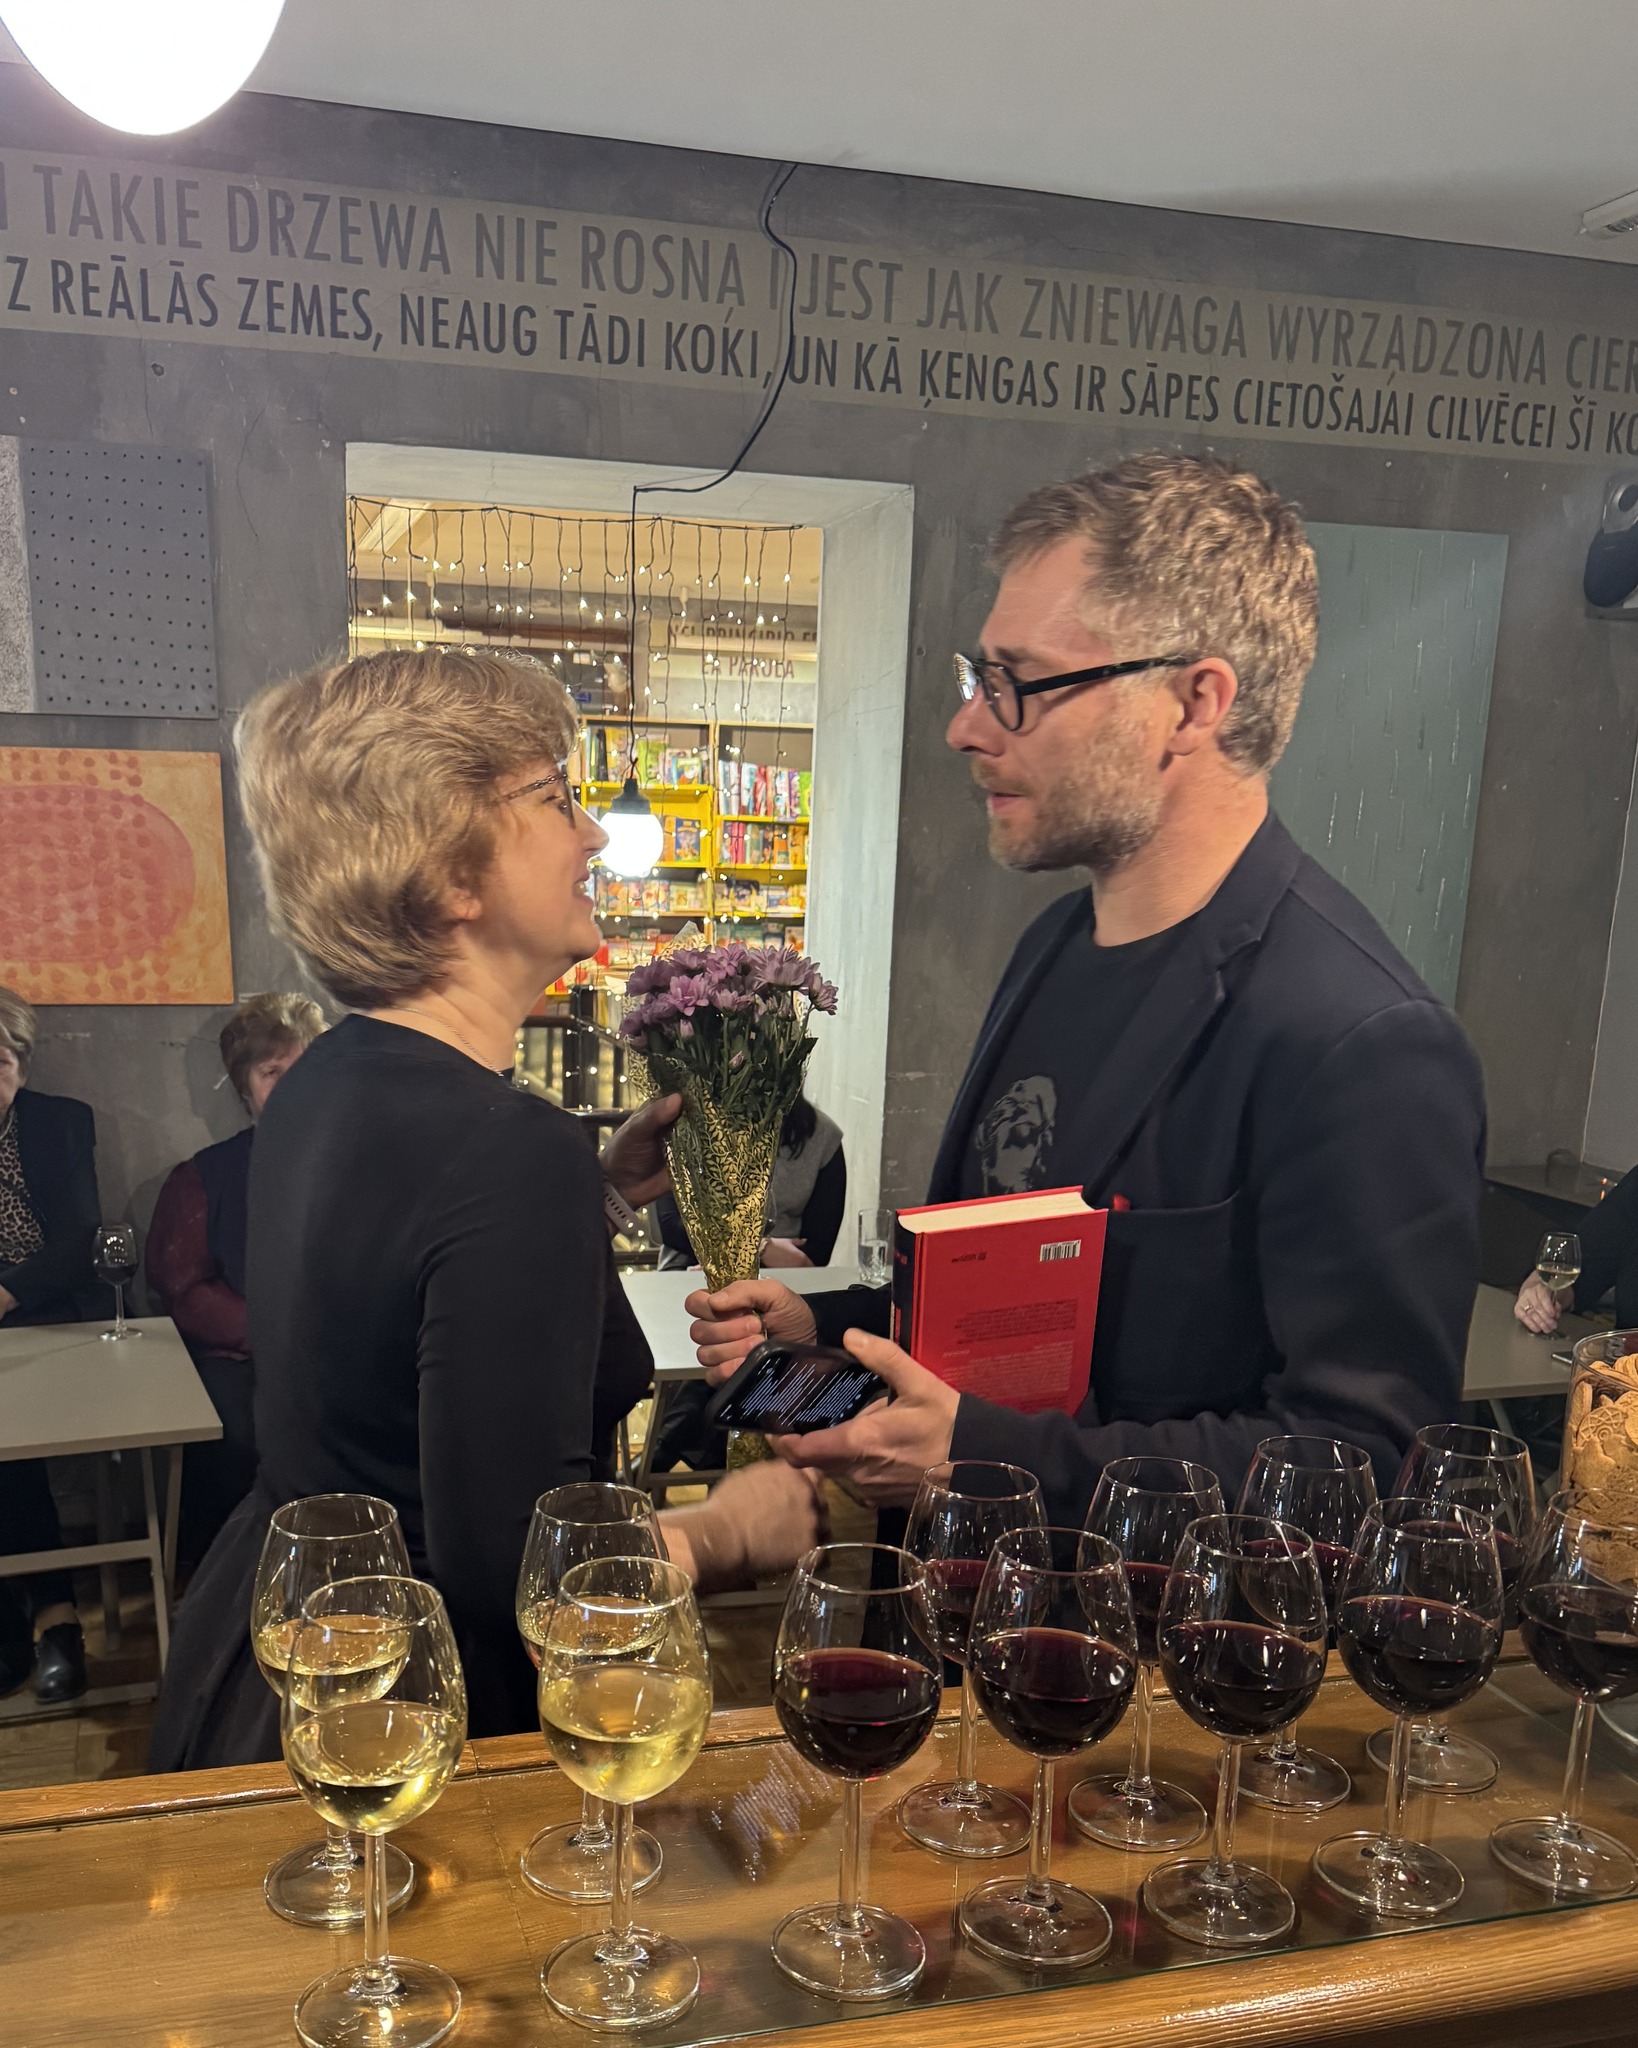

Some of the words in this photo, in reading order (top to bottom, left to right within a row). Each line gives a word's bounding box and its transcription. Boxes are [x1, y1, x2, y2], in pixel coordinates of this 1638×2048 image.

[6, 255, 31, 312] Z
[51, 254, 219, 328] REĀLĀS
[237, 277, 383, 352] ZEMES,
[400, 293, 537, 357] NEAUG
[553, 302, 646, 368] TĀDI
[788, 335, 837, 388] UN
[854, 336, 902, 395] KĀ
[919, 348, 1060, 409] ĶENGAS
[1074, 364, 1107, 414] IR
[1119, 362, 1220, 422] SĀPES
[1427, 392, 1556, 448] CILVĒCEI
[1566, 394, 1598, 452] ŠĪ
[33, 164, 202, 249] TAKIE
[226, 184, 450, 275] DRZEWA
[475, 212, 558, 286] NIE
[769, 248, 779, 310] I
[799, 252, 903, 324] JEST
[916, 267, 1003, 334] JAK
[1019, 277, 1247, 359] ZNIEWAGA
